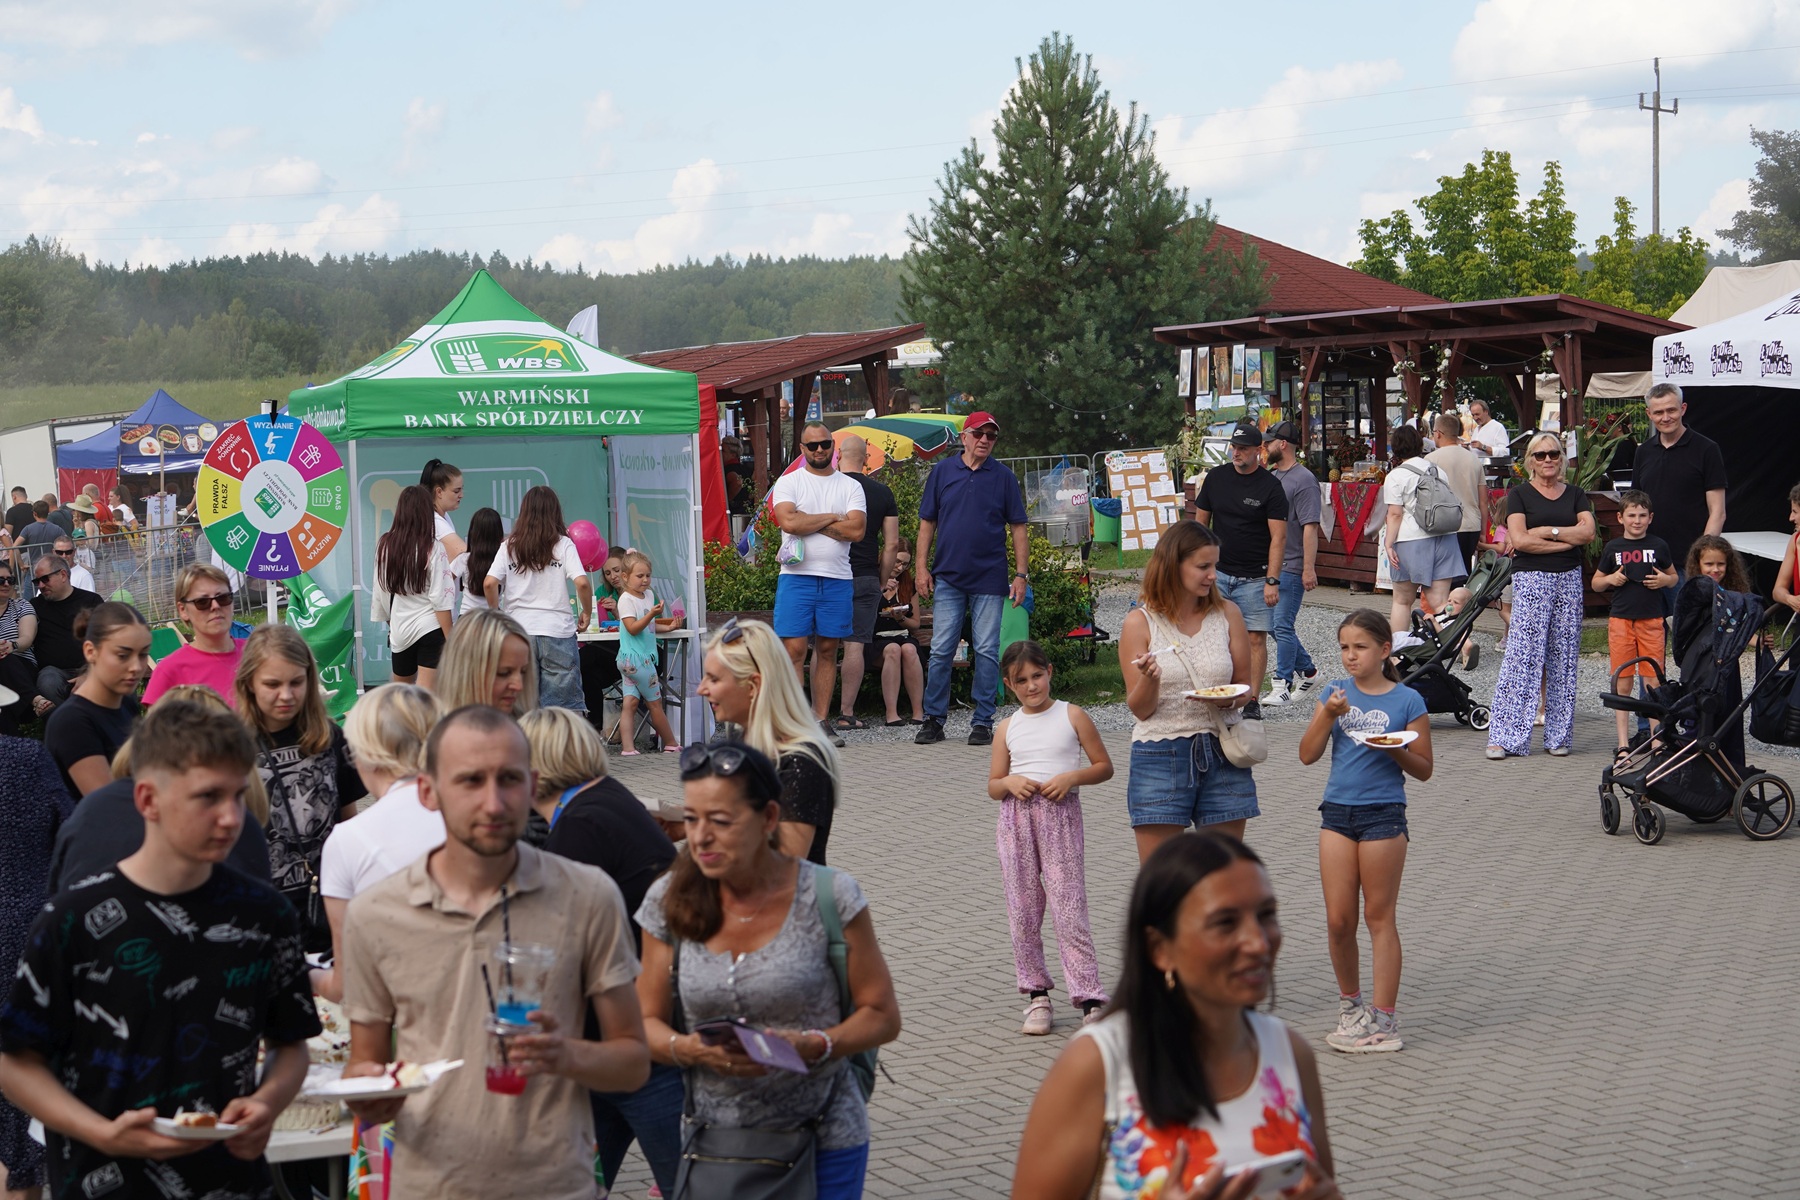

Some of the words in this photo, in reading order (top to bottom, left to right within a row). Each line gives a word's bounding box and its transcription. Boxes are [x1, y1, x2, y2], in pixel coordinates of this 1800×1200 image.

[903, 344, 938, 355] GOFR
[497, 357, 564, 369] WBS
[457, 386, 590, 406] WARMIŃSKI
[253, 421, 294, 430] WYZWANIE
[404, 414, 467, 428] BANK
[476, 407, 645, 427] SPÓŁDZIELCZY
[216, 433, 236, 454] ZAKRĘĆ
[217, 435, 243, 462] PONOWNIE
[334, 493, 342, 511] NAS
[306, 534, 332, 561] MUZYKA
[1622, 549, 1642, 564] DO
[258, 564, 289, 572] PYTANIE
